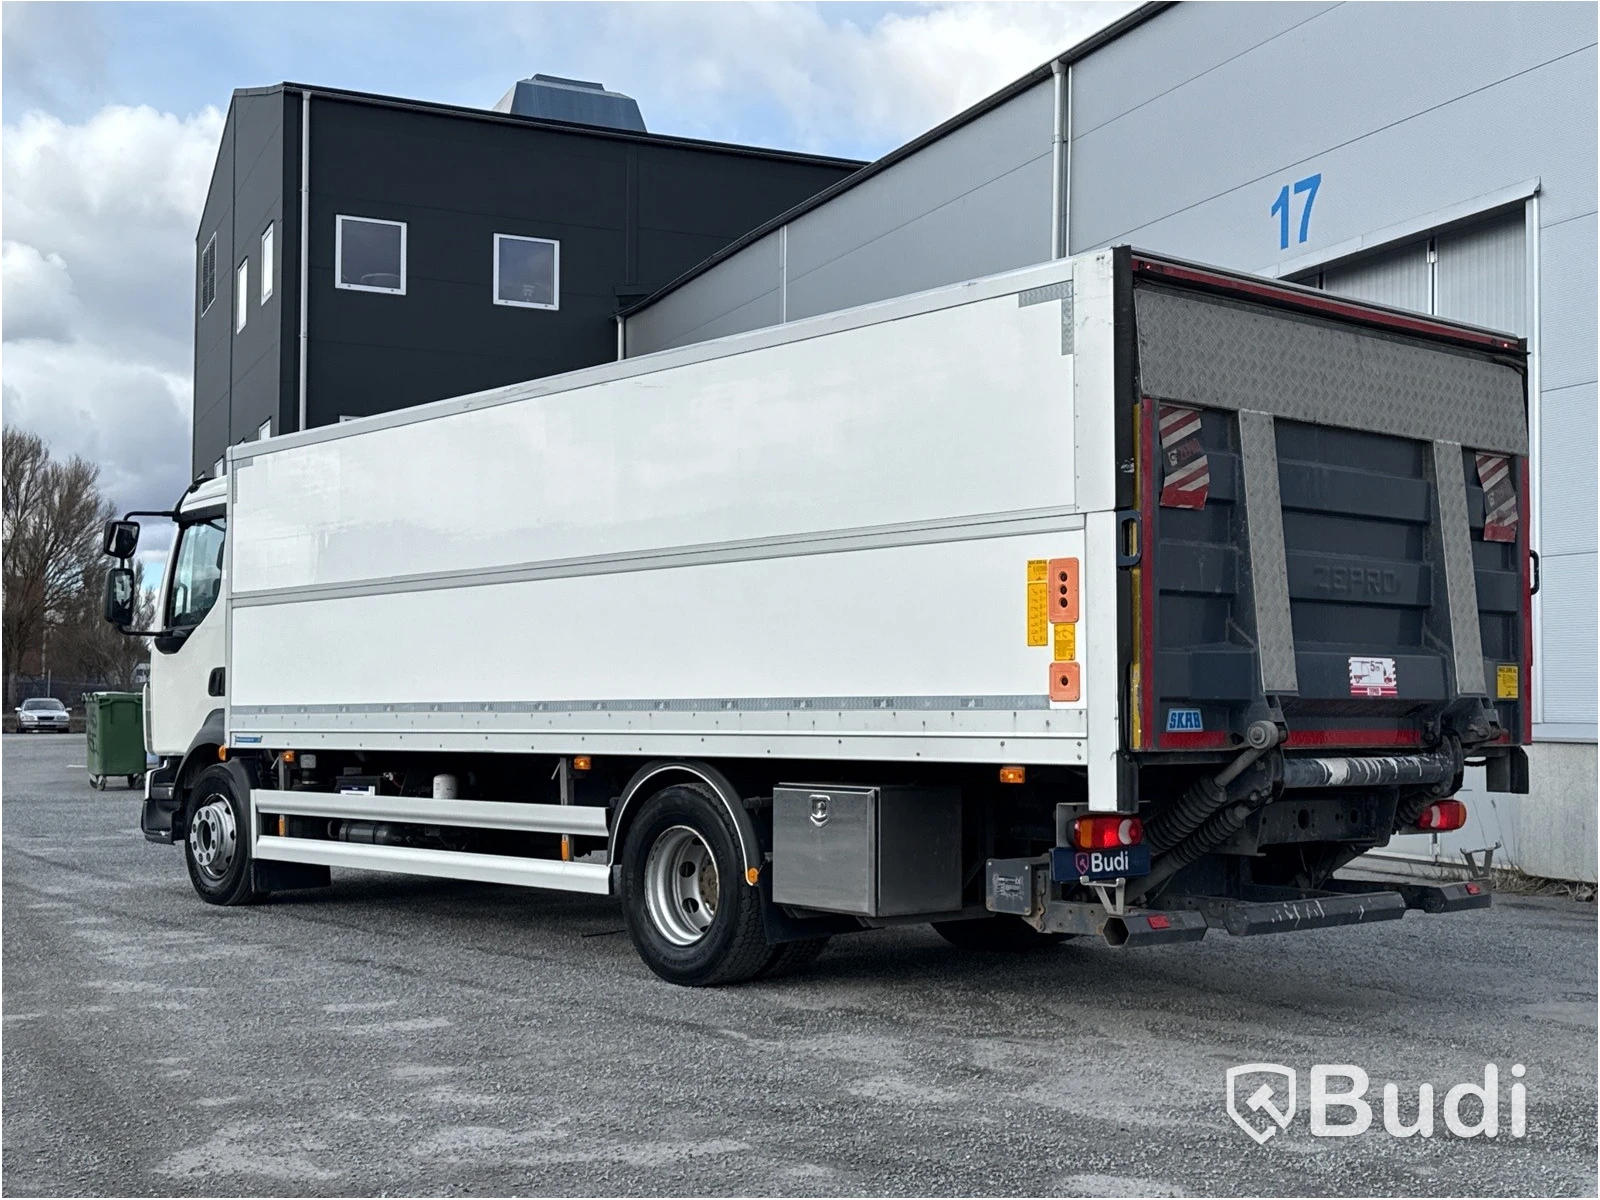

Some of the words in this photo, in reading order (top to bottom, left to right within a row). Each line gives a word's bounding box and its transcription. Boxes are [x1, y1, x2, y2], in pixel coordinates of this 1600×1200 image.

[1271, 173, 1322, 250] 17
[1314, 565, 1398, 594] ZEPRO
[1169, 711, 1202, 729] SKAB
[1091, 851, 1129, 873] Budi
